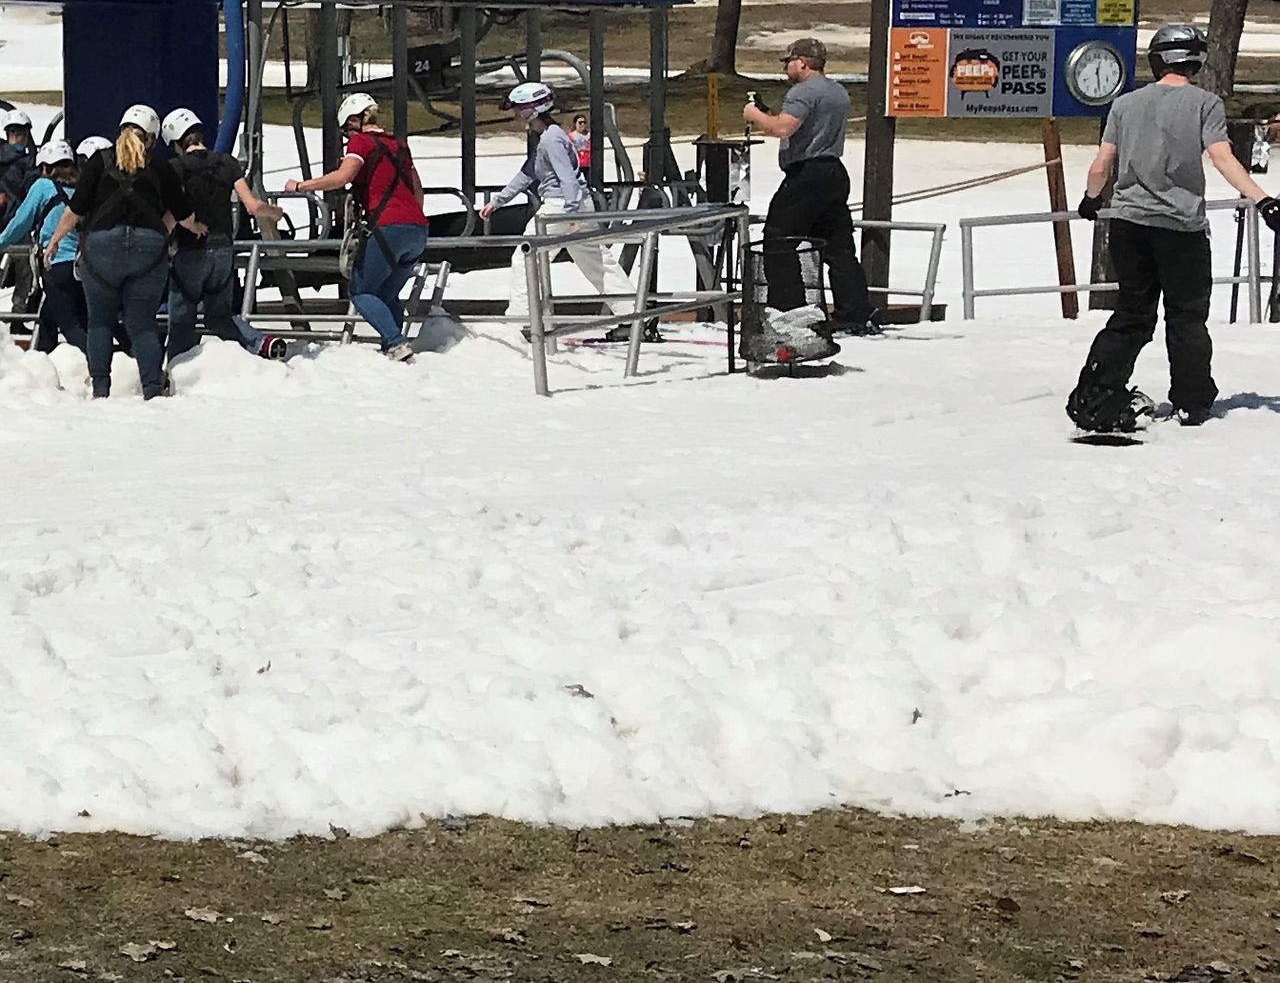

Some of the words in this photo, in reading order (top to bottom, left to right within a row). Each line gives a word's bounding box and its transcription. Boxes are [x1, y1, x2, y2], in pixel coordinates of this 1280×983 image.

[1002, 51, 1019, 62] GET
[1020, 51, 1047, 62] YOUR
[415, 59, 430, 73] 24
[1001, 82, 1047, 95] PASS
